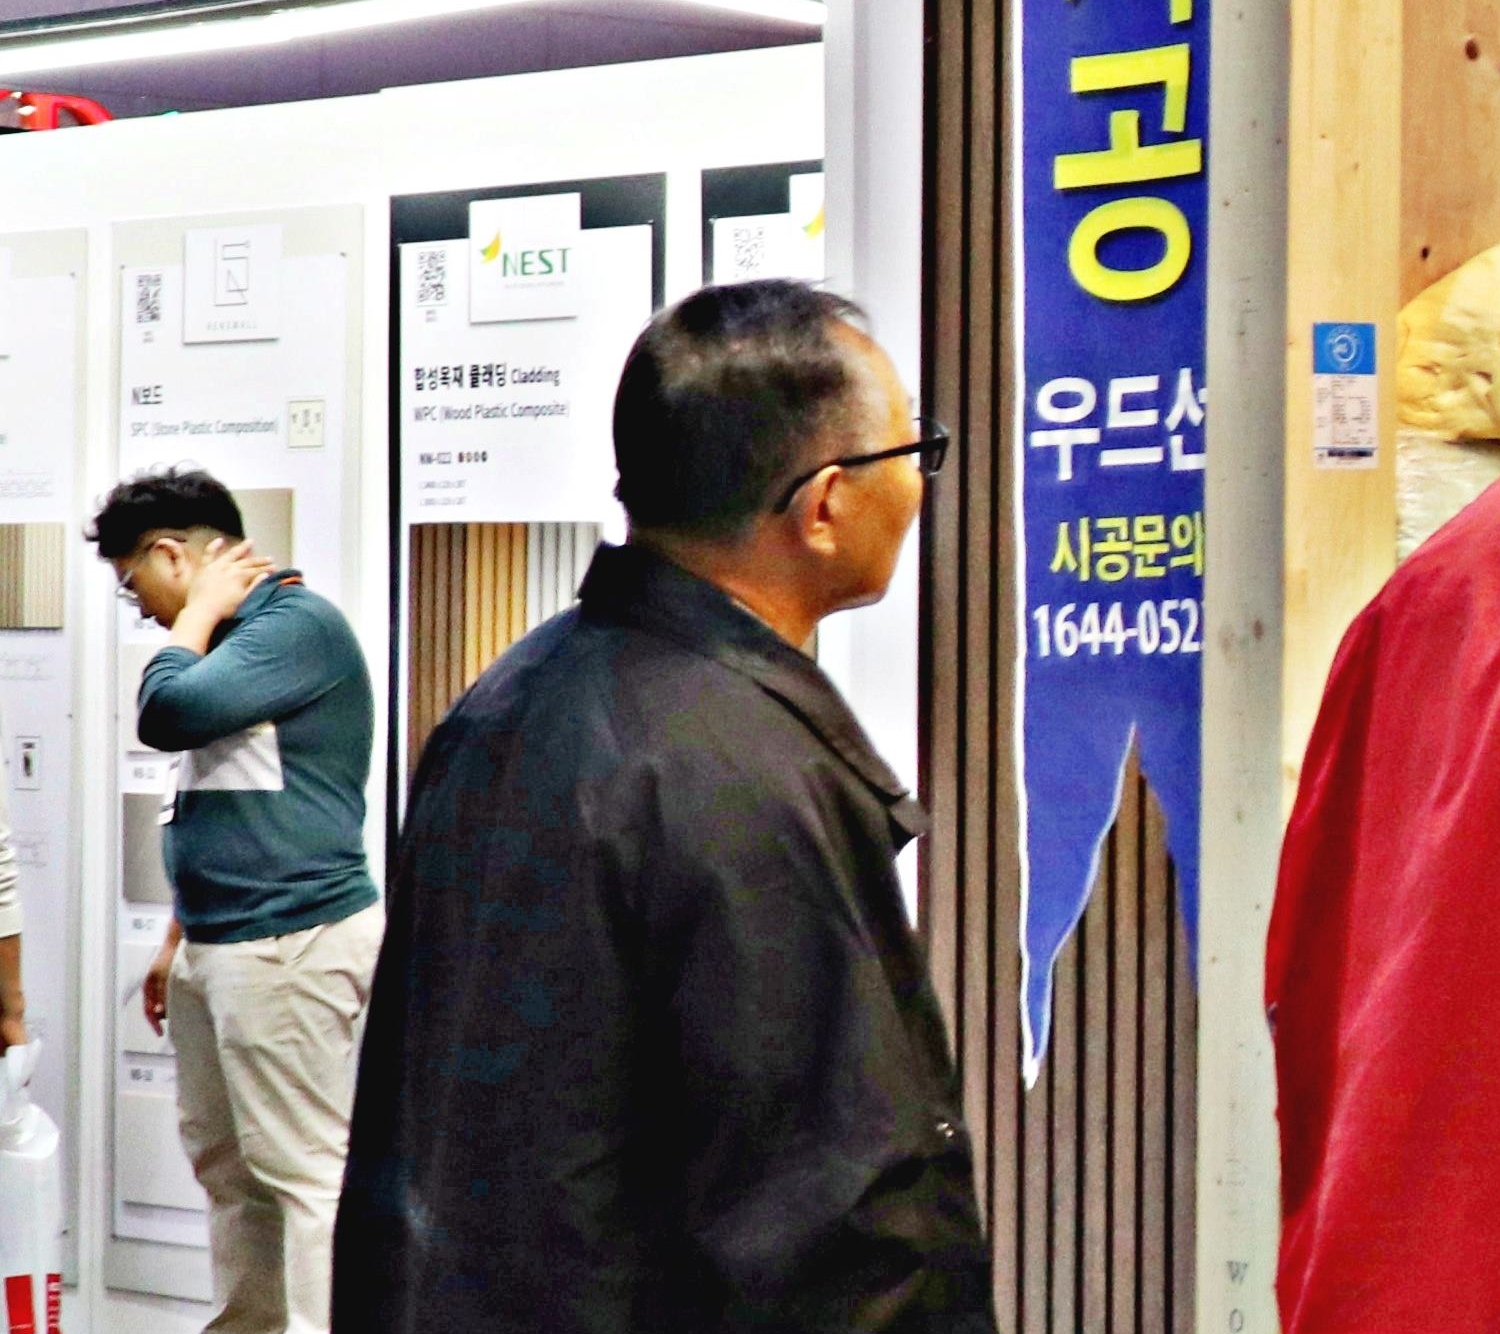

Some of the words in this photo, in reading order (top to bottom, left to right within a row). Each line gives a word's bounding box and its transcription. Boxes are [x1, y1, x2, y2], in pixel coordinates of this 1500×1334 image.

[502, 247, 572, 277] NEST
[414, 366, 465, 391] 합성목재
[469, 363, 507, 389] 클래딩
[511, 367, 560, 387] Cladding
[1050, 511, 1204, 582] 시공문의
